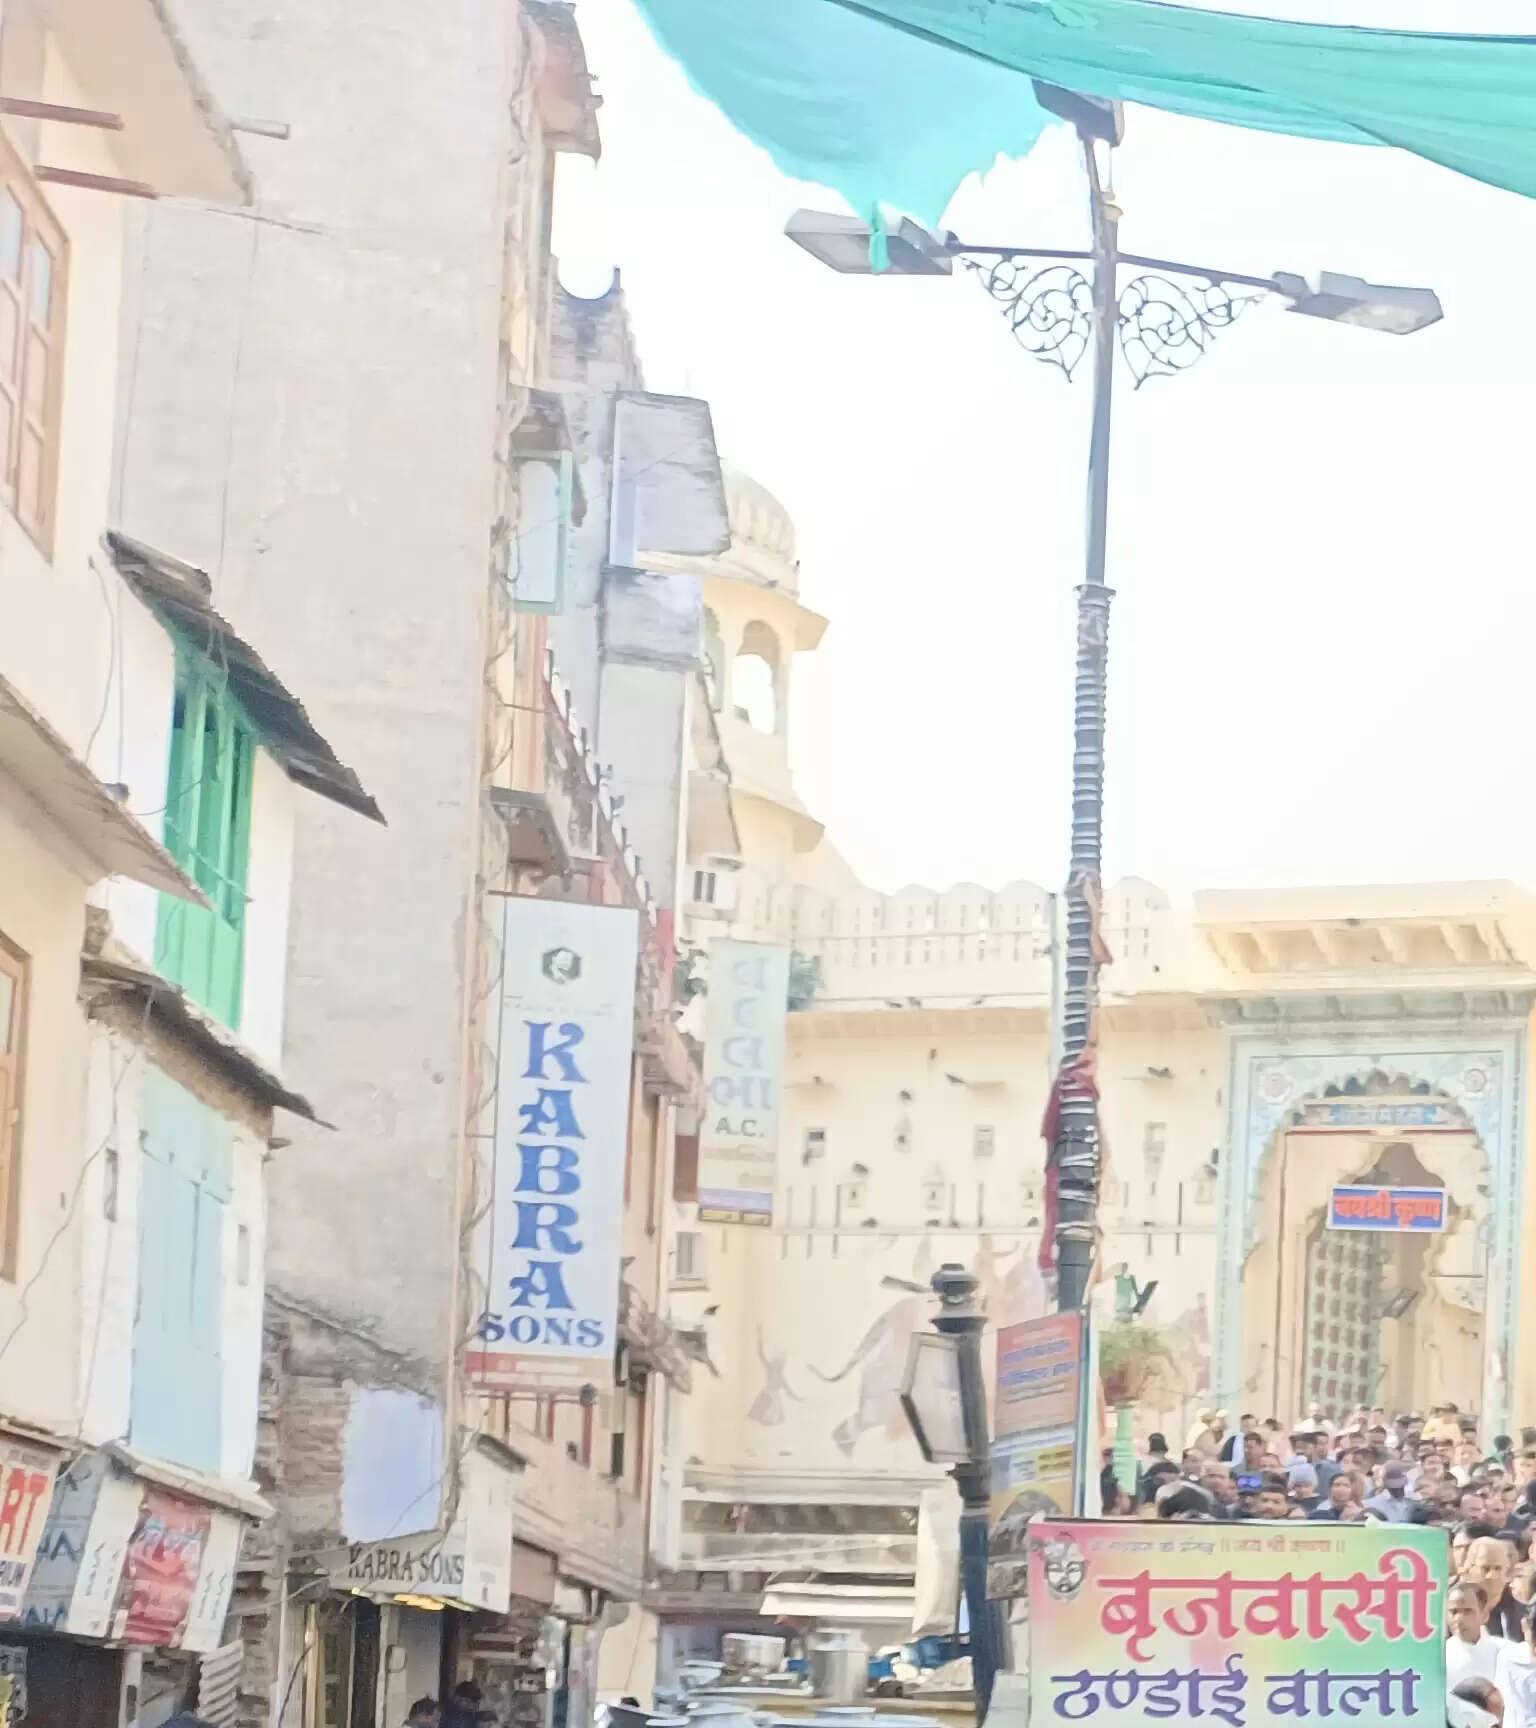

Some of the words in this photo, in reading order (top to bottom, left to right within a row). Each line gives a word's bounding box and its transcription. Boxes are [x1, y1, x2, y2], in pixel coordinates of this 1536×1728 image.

[509, 1019, 590, 1312] KABRA
[477, 1313, 605, 1349] SONS
[348, 1541, 414, 1582] KABRA
[418, 1551, 464, 1585] SONS
[1097, 1546, 1438, 1663] बृजवासी
[1050, 1652, 1249, 1728] ठण्डाई
[1263, 1667, 1422, 1718] वाला
